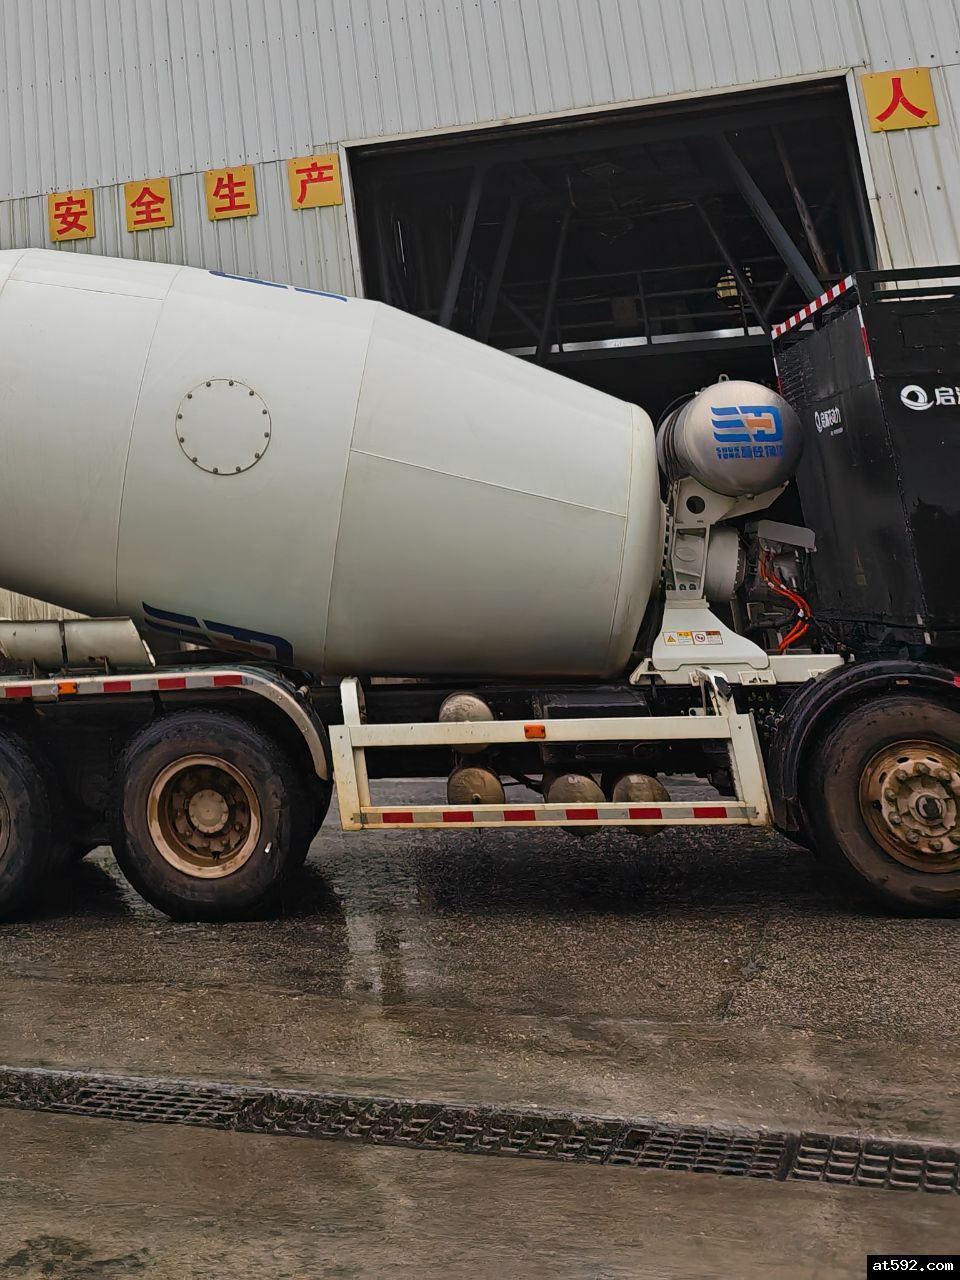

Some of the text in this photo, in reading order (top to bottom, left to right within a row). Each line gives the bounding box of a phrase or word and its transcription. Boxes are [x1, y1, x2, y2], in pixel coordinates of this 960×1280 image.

[875, 77, 929, 122] 人
[53, 161, 335, 236] 安全生产
[934, 386, 960, 406] 启
